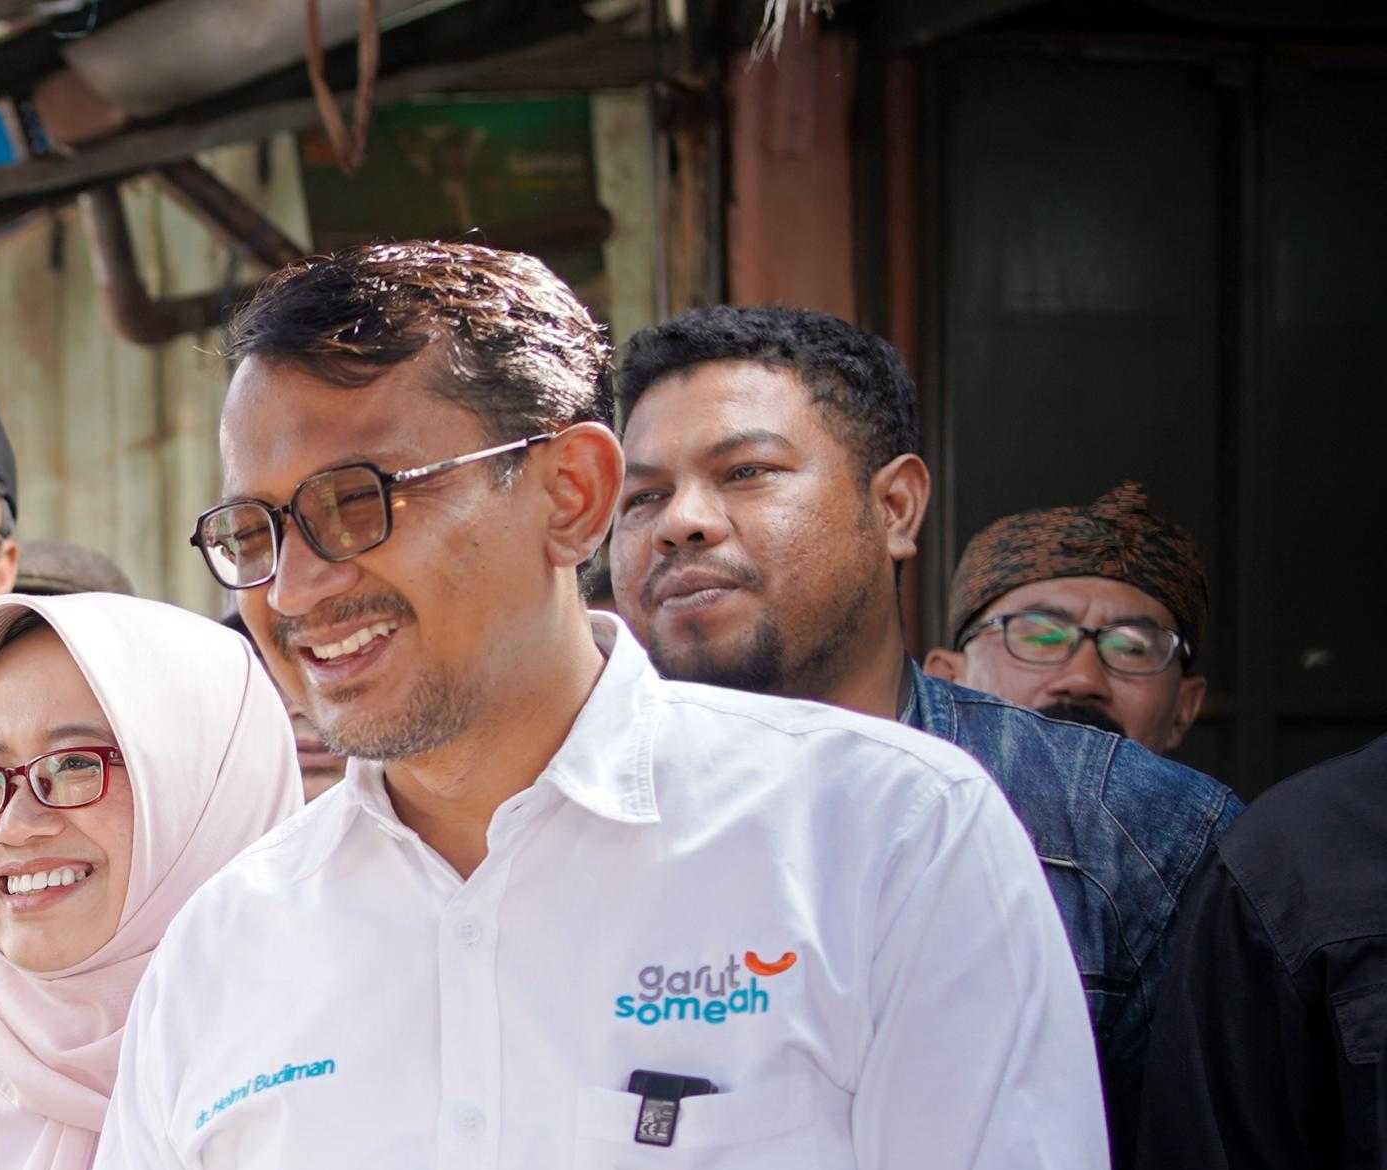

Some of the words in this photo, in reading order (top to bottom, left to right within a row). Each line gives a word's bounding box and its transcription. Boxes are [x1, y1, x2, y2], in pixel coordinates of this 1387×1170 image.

[614, 977, 769, 1026] someah
[637, 954, 741, 1002] garut
[253, 1058, 336, 1093] Budiman
